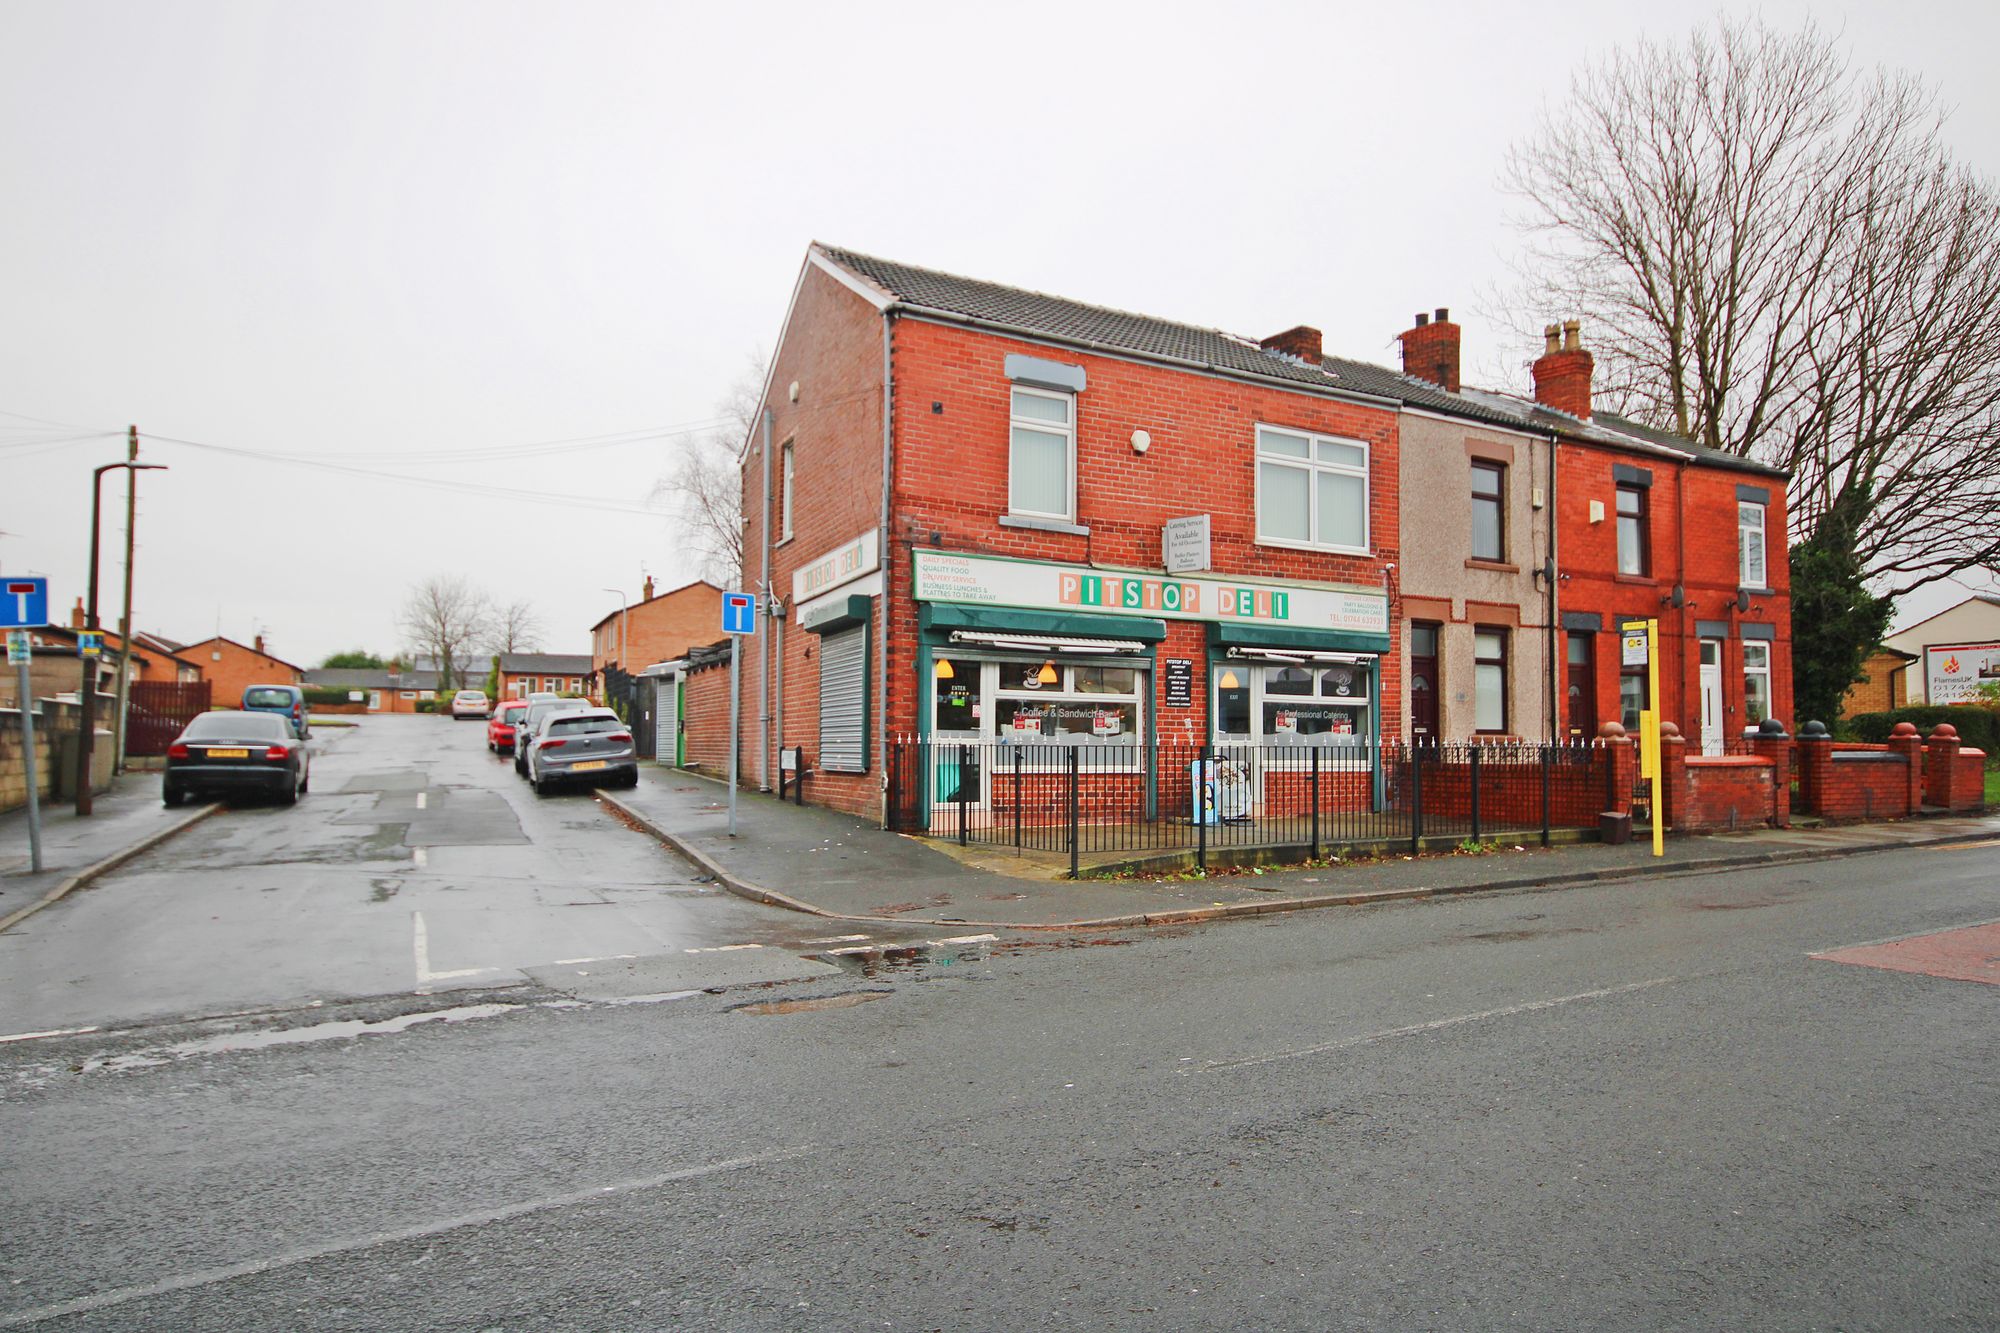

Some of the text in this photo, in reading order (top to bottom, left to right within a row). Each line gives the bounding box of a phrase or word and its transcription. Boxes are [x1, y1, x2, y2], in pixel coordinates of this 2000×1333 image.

[1175, 530, 1199, 540] Available
[841, 544, 862, 576] DELI
[941, 557, 969, 566] SPECIALS
[922, 565, 949, 573] QUALITY
[922, 574, 976, 584] DELIVERY SERVICE
[922, 583, 952, 591] BUSINESS
[954, 585, 982, 593] LUNCHES
[1061, 575, 1285, 617] PITSTOP DELI
[1022, 707, 1048, 717] Coffee
[1050, 708, 1056, 717] &
[1058, 708, 1097, 719] Sandwich
[1284, 709, 1322, 719] Professional
[1323, 710, 1349, 720] Catering
